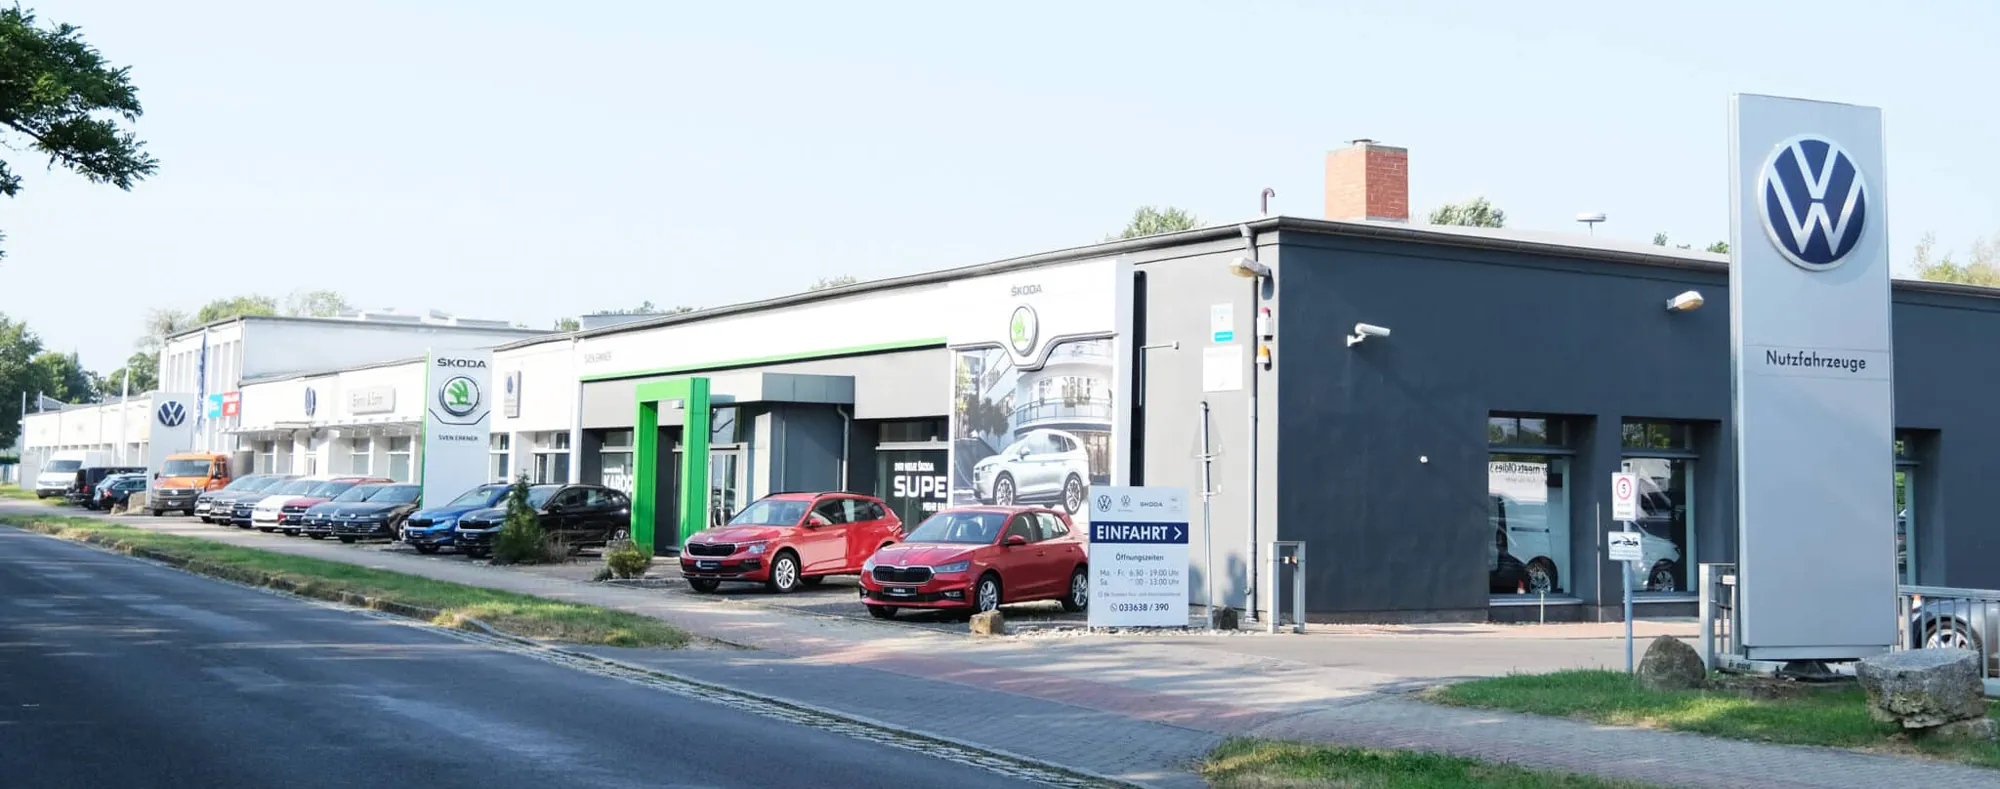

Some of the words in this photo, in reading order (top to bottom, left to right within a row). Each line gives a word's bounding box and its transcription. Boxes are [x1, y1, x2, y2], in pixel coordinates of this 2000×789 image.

[1761, 136, 1867, 267] VW
[1766, 350, 1867, 373] Nutzfahrzeuge
[157, 400, 187, 427] VW
[1621, 484, 1627, 494] 5
[1096, 525, 1168, 541] EINFAHRT
[1115, 552, 1165, 562] Öffnungszeiten
[1118, 603, 1148, 612] 033638
[1155, 603, 1169, 612] 390
